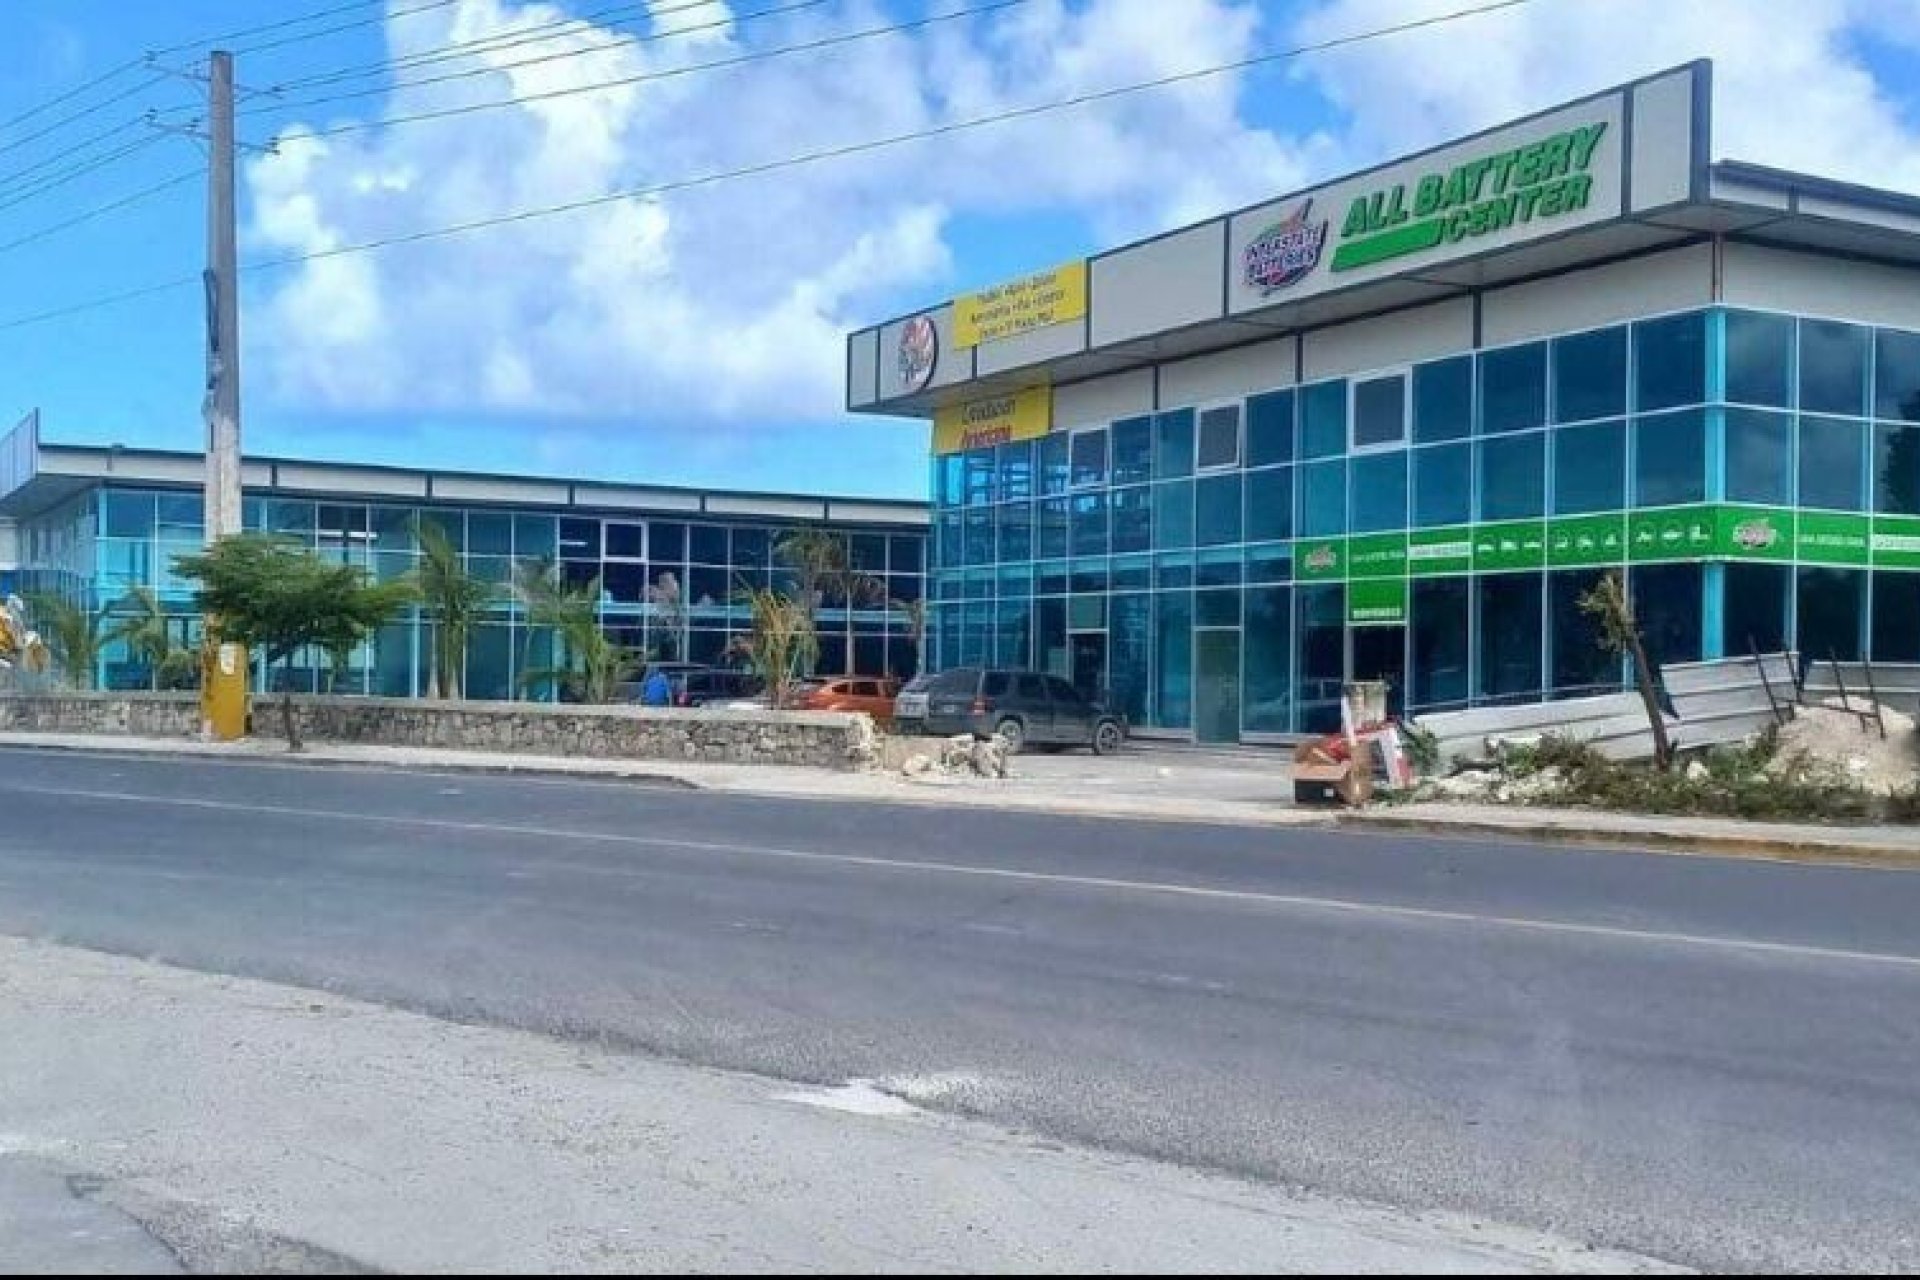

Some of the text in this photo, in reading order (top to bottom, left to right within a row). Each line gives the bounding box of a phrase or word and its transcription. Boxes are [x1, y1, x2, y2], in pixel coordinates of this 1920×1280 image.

[1341, 121, 1609, 238] ALL BATTERY
[1449, 172, 1593, 243] CENTER
